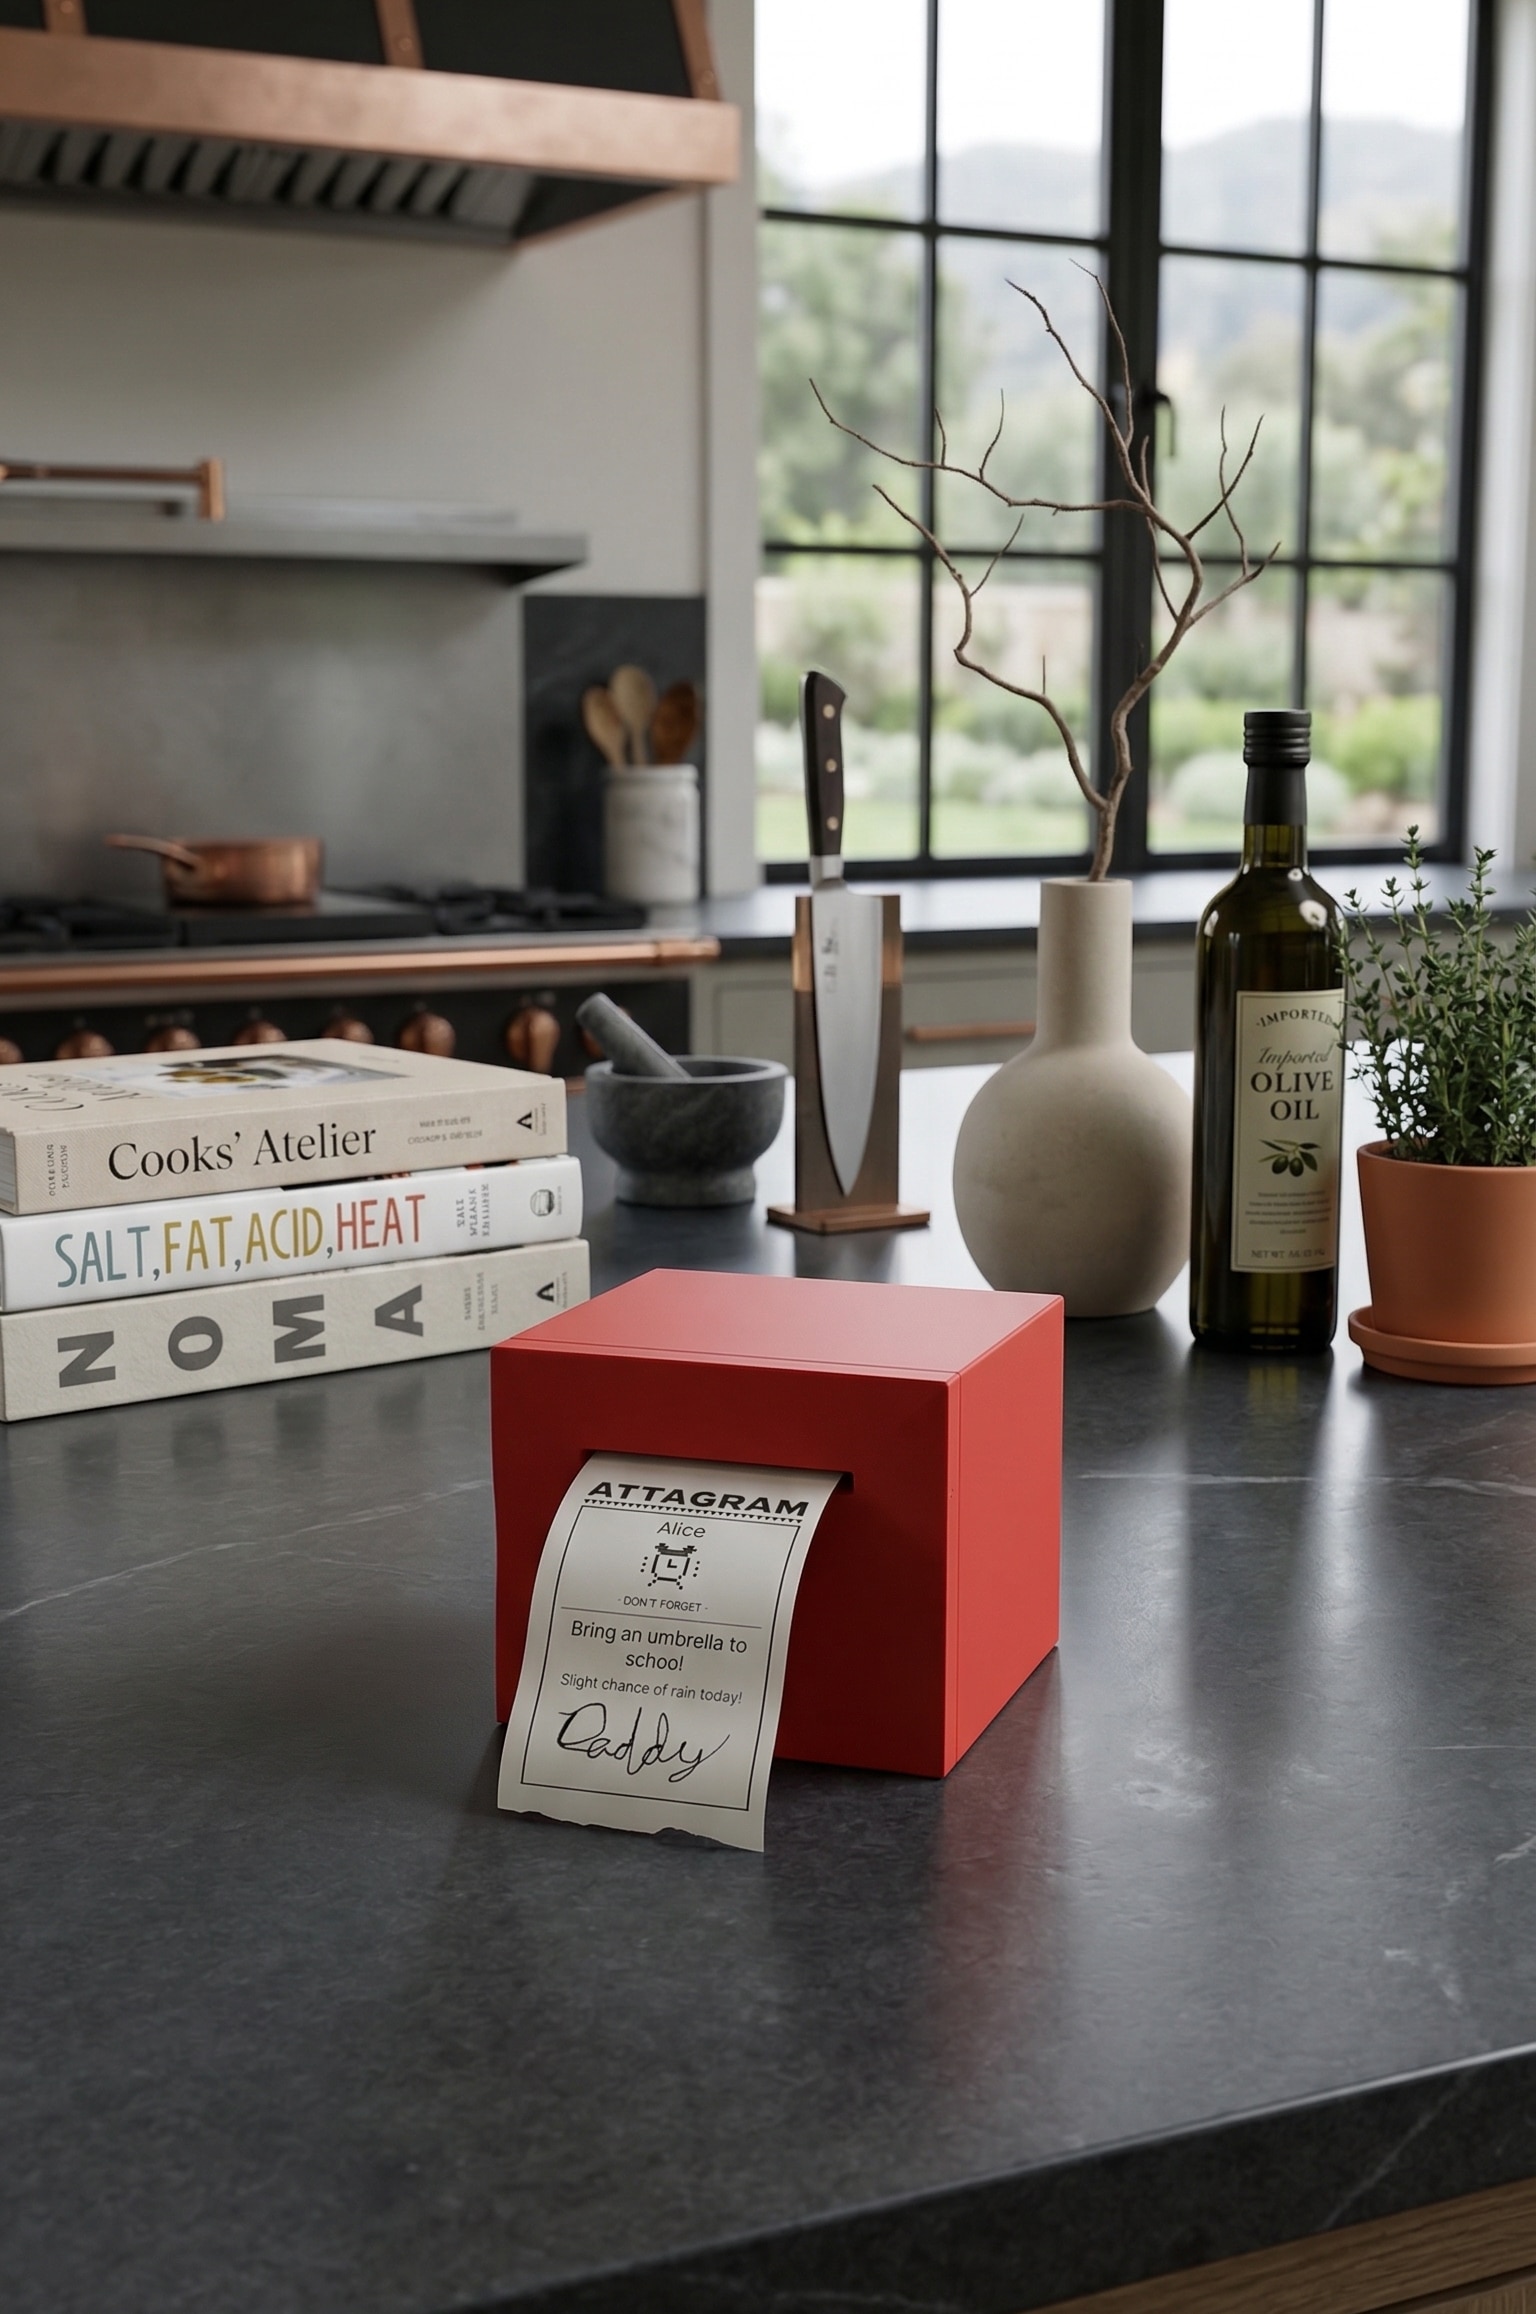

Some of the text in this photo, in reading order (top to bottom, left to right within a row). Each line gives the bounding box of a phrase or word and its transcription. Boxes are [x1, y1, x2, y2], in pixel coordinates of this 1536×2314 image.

[1260, 1009, 1333, 1027] IMPORTED
[1251, 1070, 1333, 1093] OLIVE
[1270, 1099, 1319, 1121] OIL
[253, 1122, 377, 1166] Atelier
[337, 1194, 426, 1252] HEAT
[588, 1481, 809, 1517] ATTAGRAM
[656, 1521, 706, 1538] Alice
[623, 1595, 702, 1612] DONT FORGET
[571, 1620, 747, 1653] Bring an umbrella to
[560, 1673, 743, 1706] Slight chance of rain today!
[557, 1703, 730, 1782] Daddy
